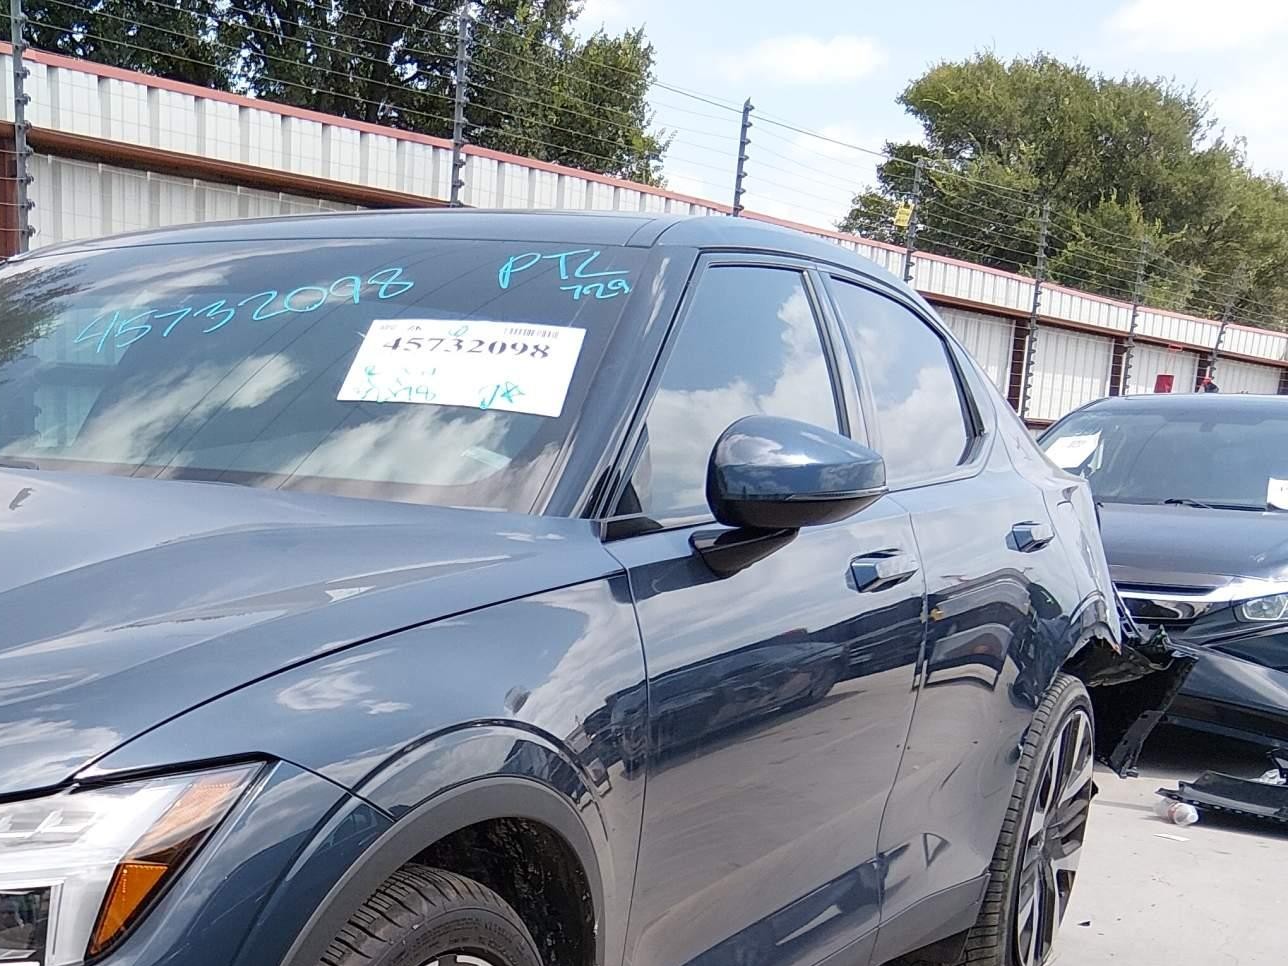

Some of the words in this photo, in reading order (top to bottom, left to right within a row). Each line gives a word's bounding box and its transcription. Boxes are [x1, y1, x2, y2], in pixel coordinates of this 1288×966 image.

[559, 279, 631, 300] 729
[74, 268, 415, 353] 45732098
[383, 336, 552, 359] 45732098
